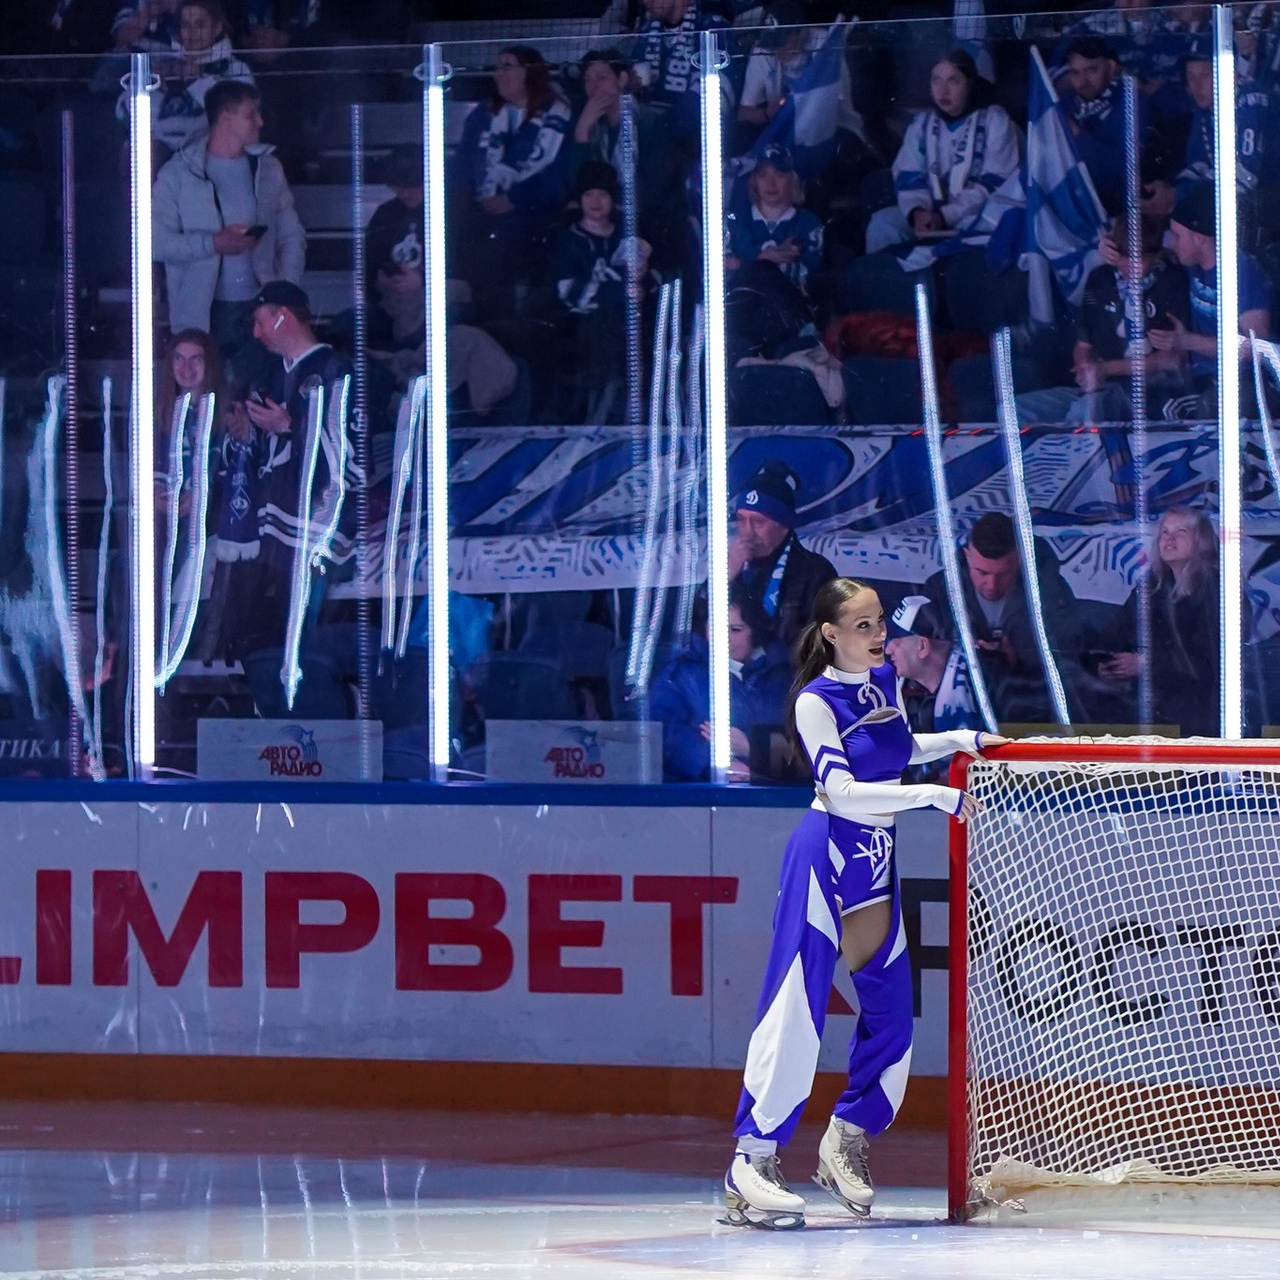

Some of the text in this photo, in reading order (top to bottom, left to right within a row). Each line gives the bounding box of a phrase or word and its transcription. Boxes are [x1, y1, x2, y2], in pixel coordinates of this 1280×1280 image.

[259, 746, 300, 761] АВТО
[543, 747, 583, 763] АВТО
[270, 760, 322, 776] РАДИО
[554, 762, 605, 778] РАДИО
[0, 869, 739, 996] IMPBET
